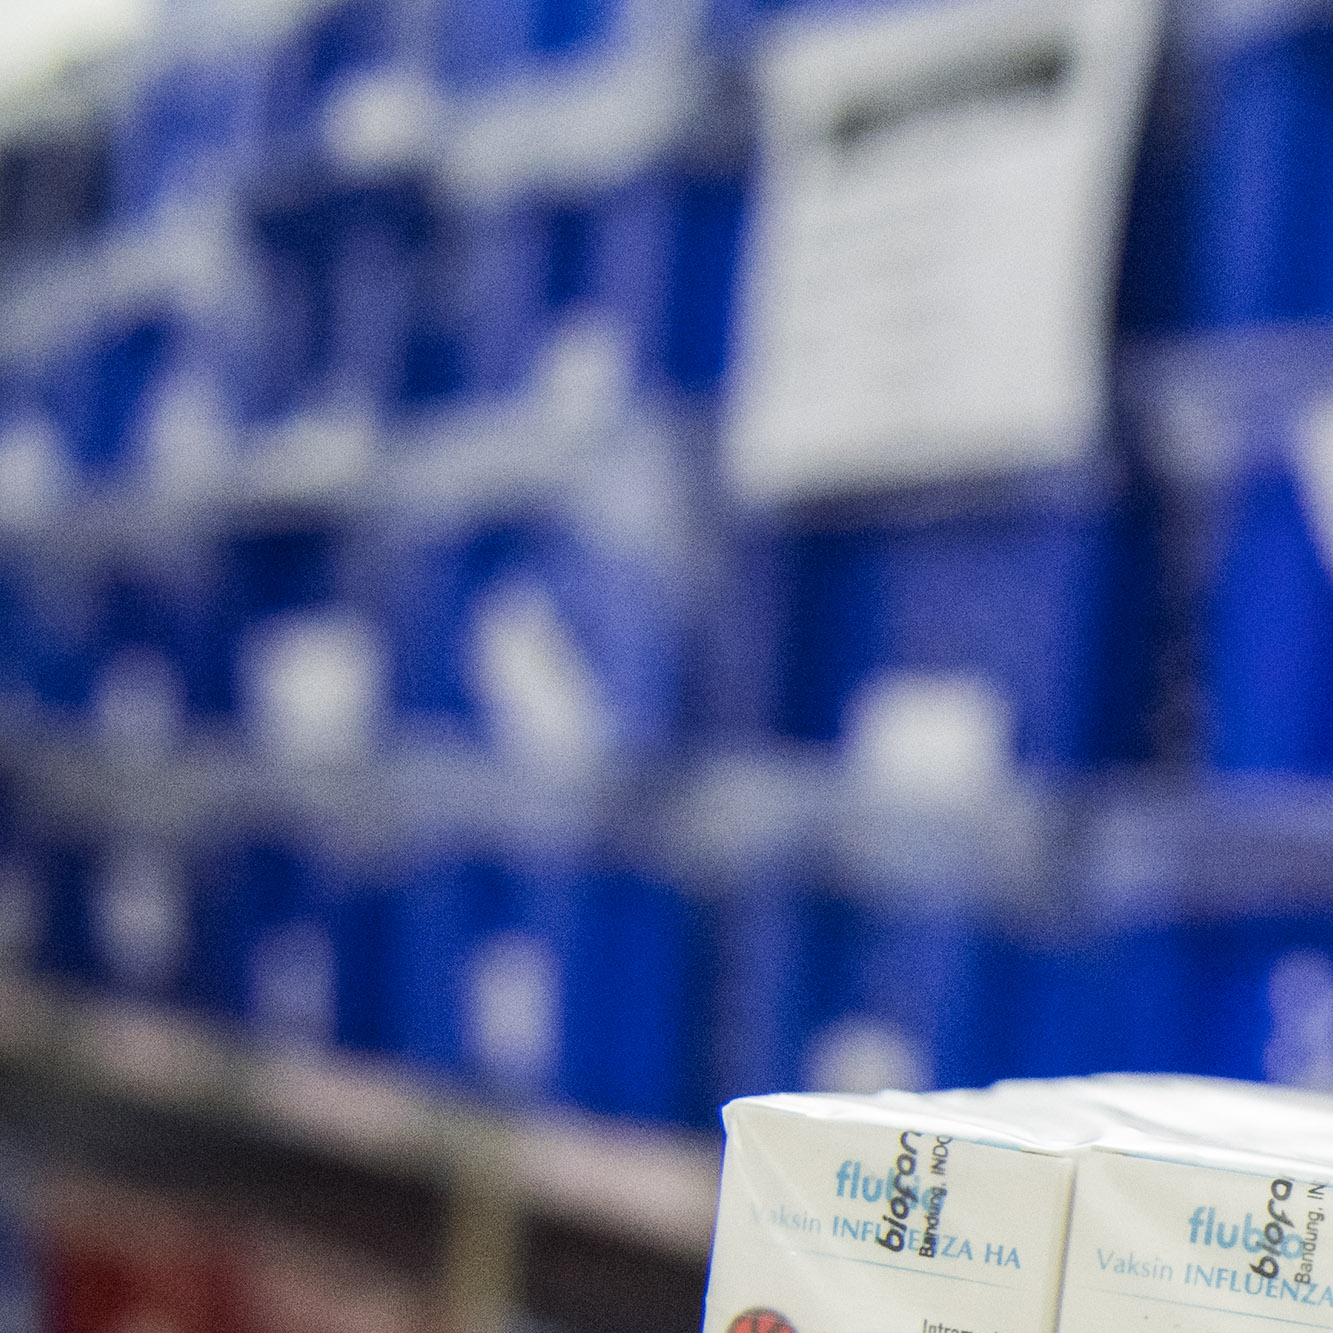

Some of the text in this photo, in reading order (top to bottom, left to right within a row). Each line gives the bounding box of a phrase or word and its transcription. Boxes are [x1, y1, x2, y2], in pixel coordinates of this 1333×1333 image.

[833, 1216, 974, 1261] INFLEZA
[985, 1243, 1021, 1269] HA
[1189, 1206, 1303, 1260] flubo
[1294, 1208, 1324, 1284] Bandung,
[1096, 1249, 1173, 1280] Vaksin
